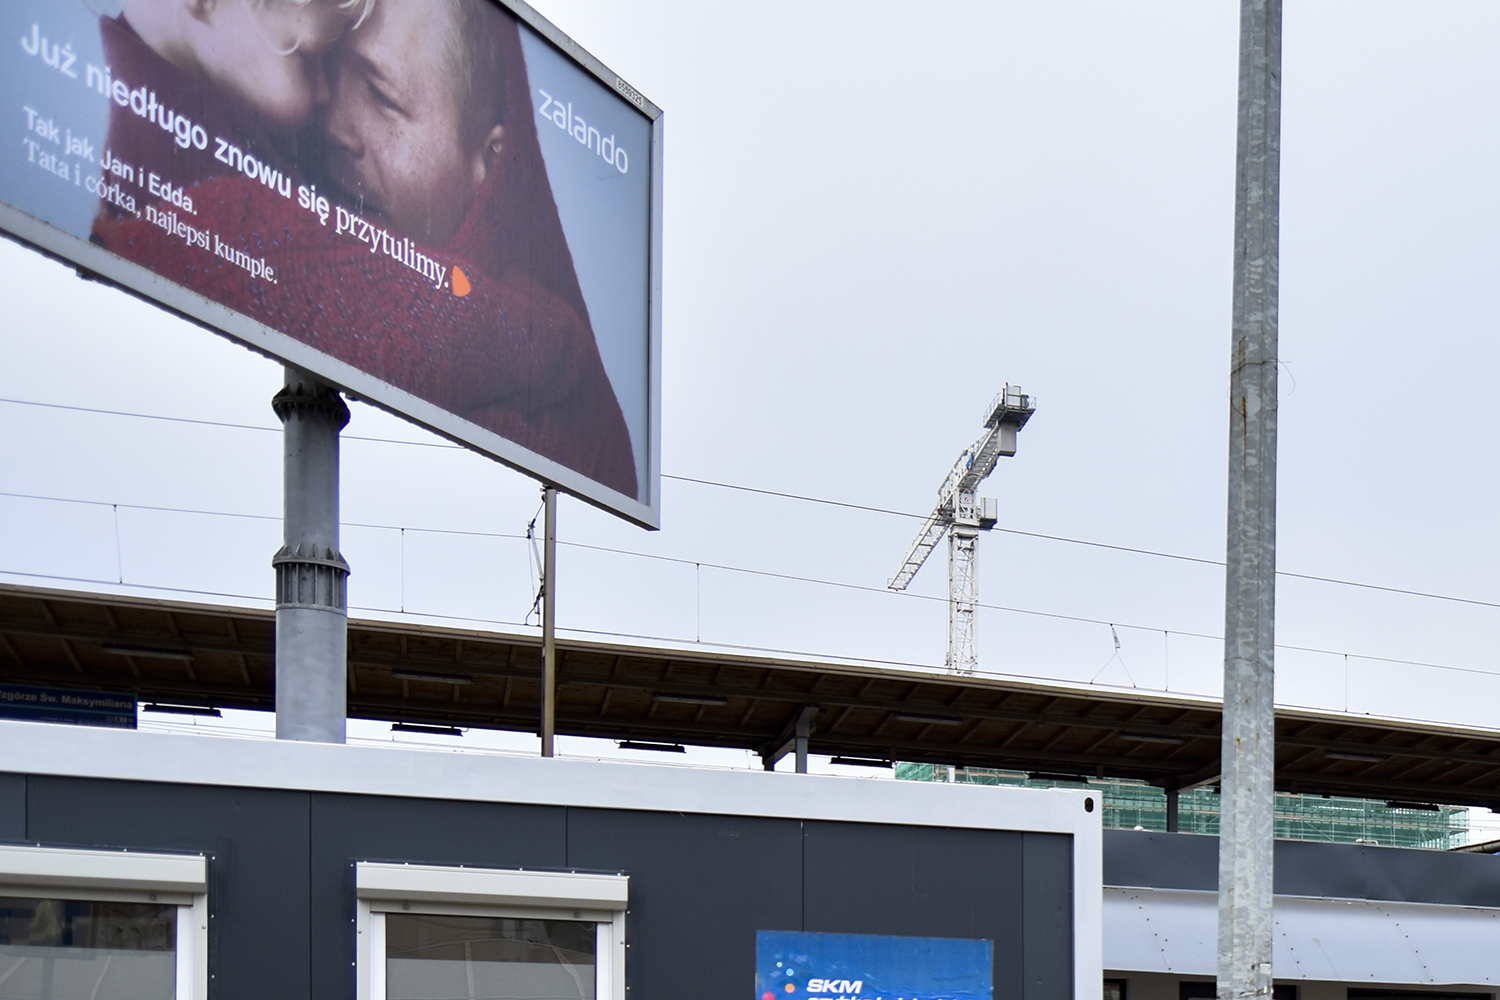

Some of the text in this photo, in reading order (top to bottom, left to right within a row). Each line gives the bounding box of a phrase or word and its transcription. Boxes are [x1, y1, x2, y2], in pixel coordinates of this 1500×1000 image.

[20, 22, 449, 289] Już niedługo znowu się przytulimy.
[22, 105, 198, 215] Tak jak Jan i Edda.
[539, 88, 628, 174] zalando
[23, 137, 278, 284] Tata i córka, najlepsi kumple.
[61, 694, 133, 709] Maksymiliana
[806, 978, 862, 994] SKM
